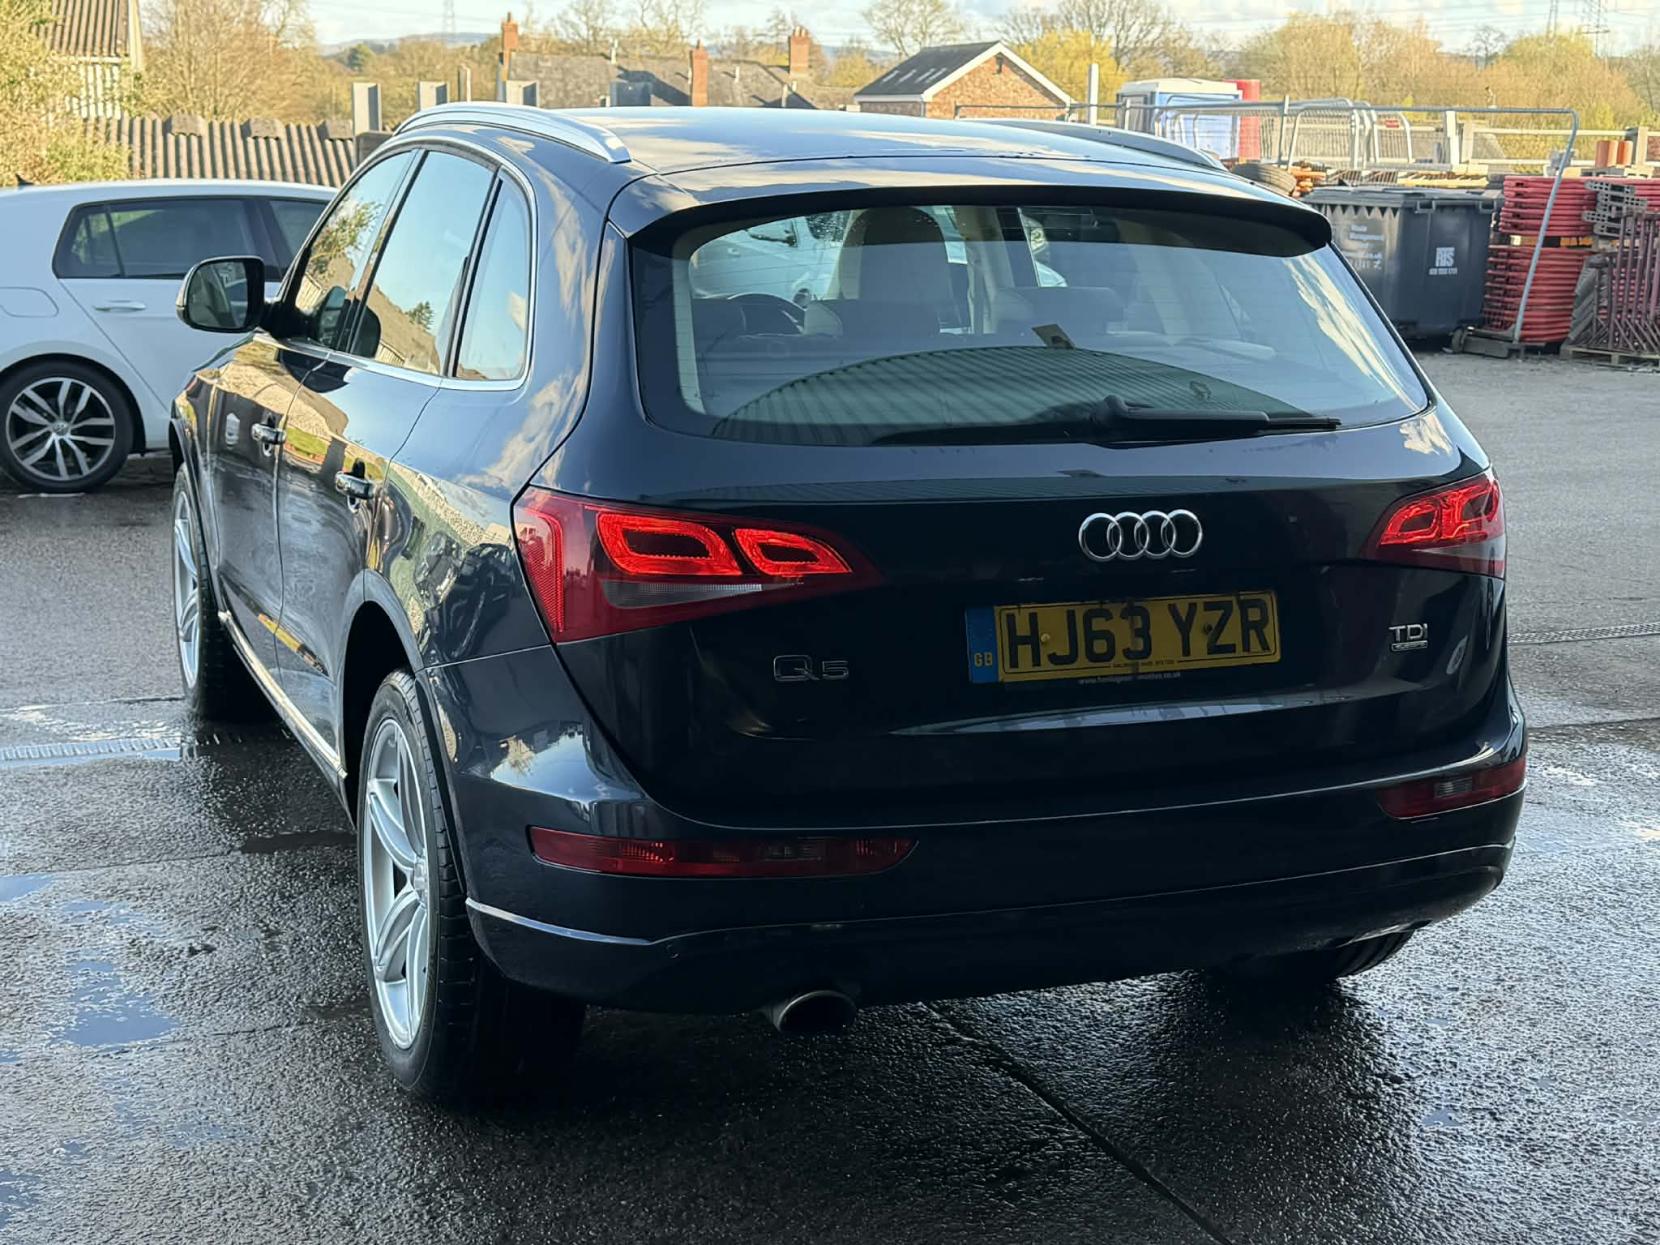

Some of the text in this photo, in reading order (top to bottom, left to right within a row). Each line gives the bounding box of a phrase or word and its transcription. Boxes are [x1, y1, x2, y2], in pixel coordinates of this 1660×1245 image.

[1006, 596, 1271, 668] HJ63 YZR
[1388, 623, 1428, 642] TDI
[773, 654, 849, 681] Q5
[974, 652, 993, 667] GB
